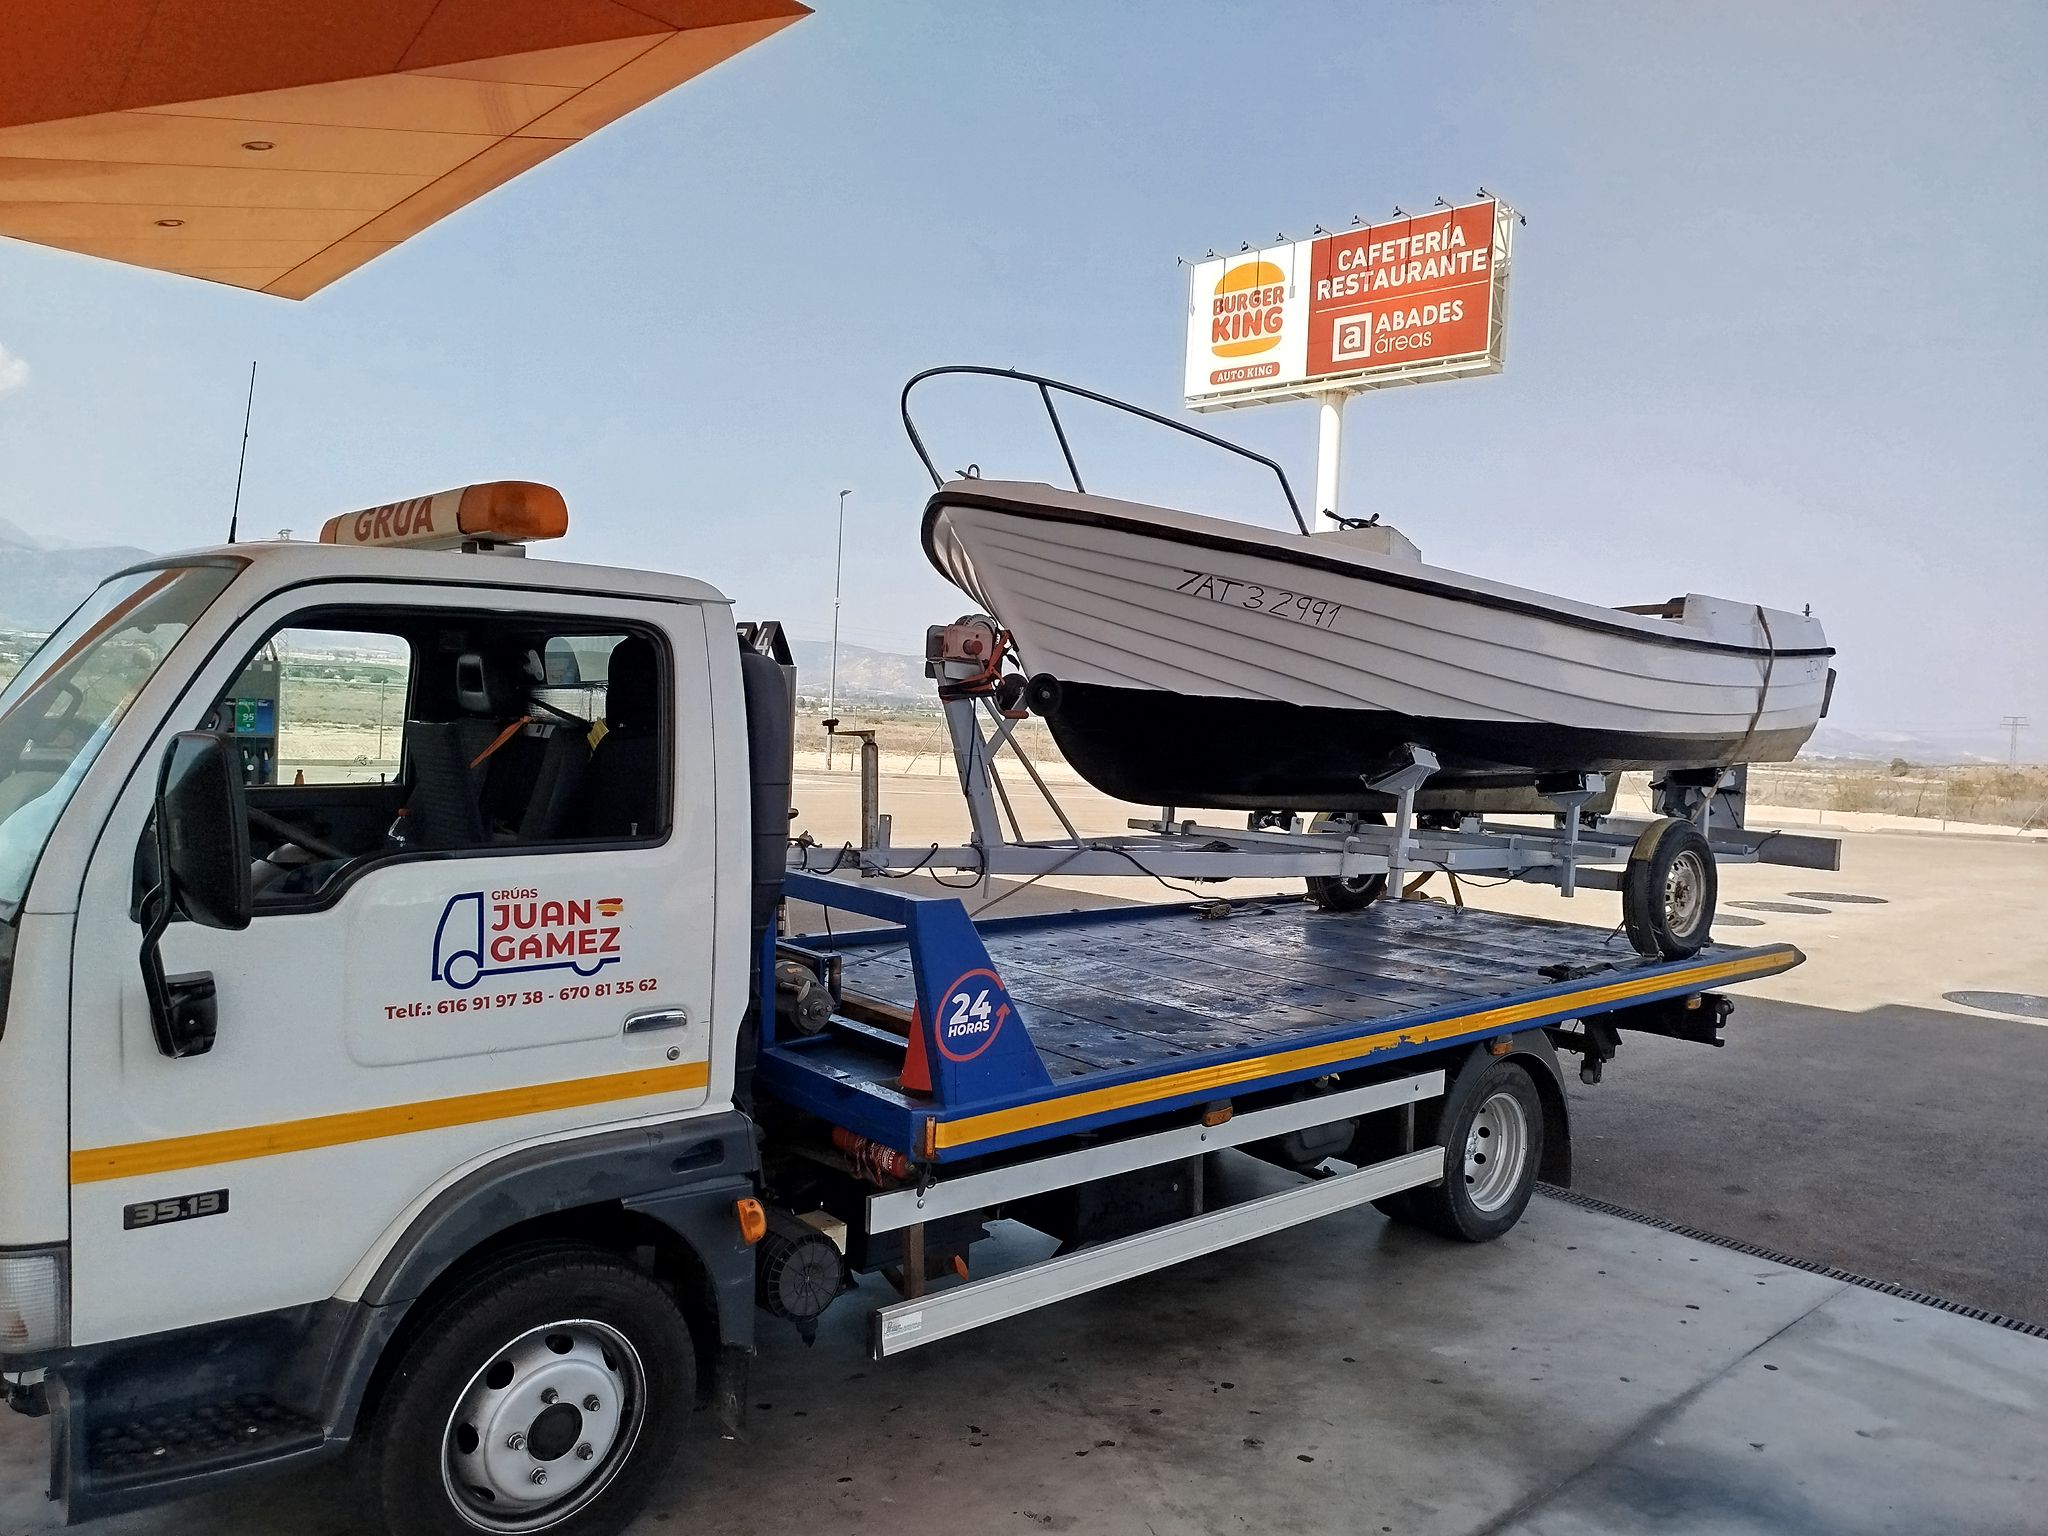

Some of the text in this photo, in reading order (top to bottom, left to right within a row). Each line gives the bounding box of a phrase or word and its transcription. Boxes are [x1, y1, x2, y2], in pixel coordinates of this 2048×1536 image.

[1337, 221, 1467, 272] CAFETERÍA
[1316, 247, 1489, 301] RESTAURANTE
[1213, 286, 1285, 316] BURGER
[1374, 299, 1465, 334] ABADES
[1211, 306, 1284, 343] KING
[1374, 331, 1433, 354] áreas
[1216, 364, 1273, 383] AUTO KING
[353, 495, 435, 542] GRUA
[755, 627, 769, 656] 4
[242, 713, 255, 721] 95
[491, 887, 538, 900] GRÚAS
[491, 899, 591, 932] JUAN
[490, 926, 621, 963] GÁMEZ
[384, 1003, 432, 1020] Telf.:
[437, 999, 468, 1014] 616
[472, 996, 490, 1010] 91
[495, 993, 518, 1008] 97
[522, 991, 543, 1005] 38
[559, 986, 590, 1001] 670
[595, 984, 611, 996] 81
[615, 981, 634, 995] 35
[638, 978, 657, 992] 62
[949, 989, 992, 1025] 24
[948, 1020, 990, 1038] HORAS
[134, 1193, 220, 1224] 35.13
